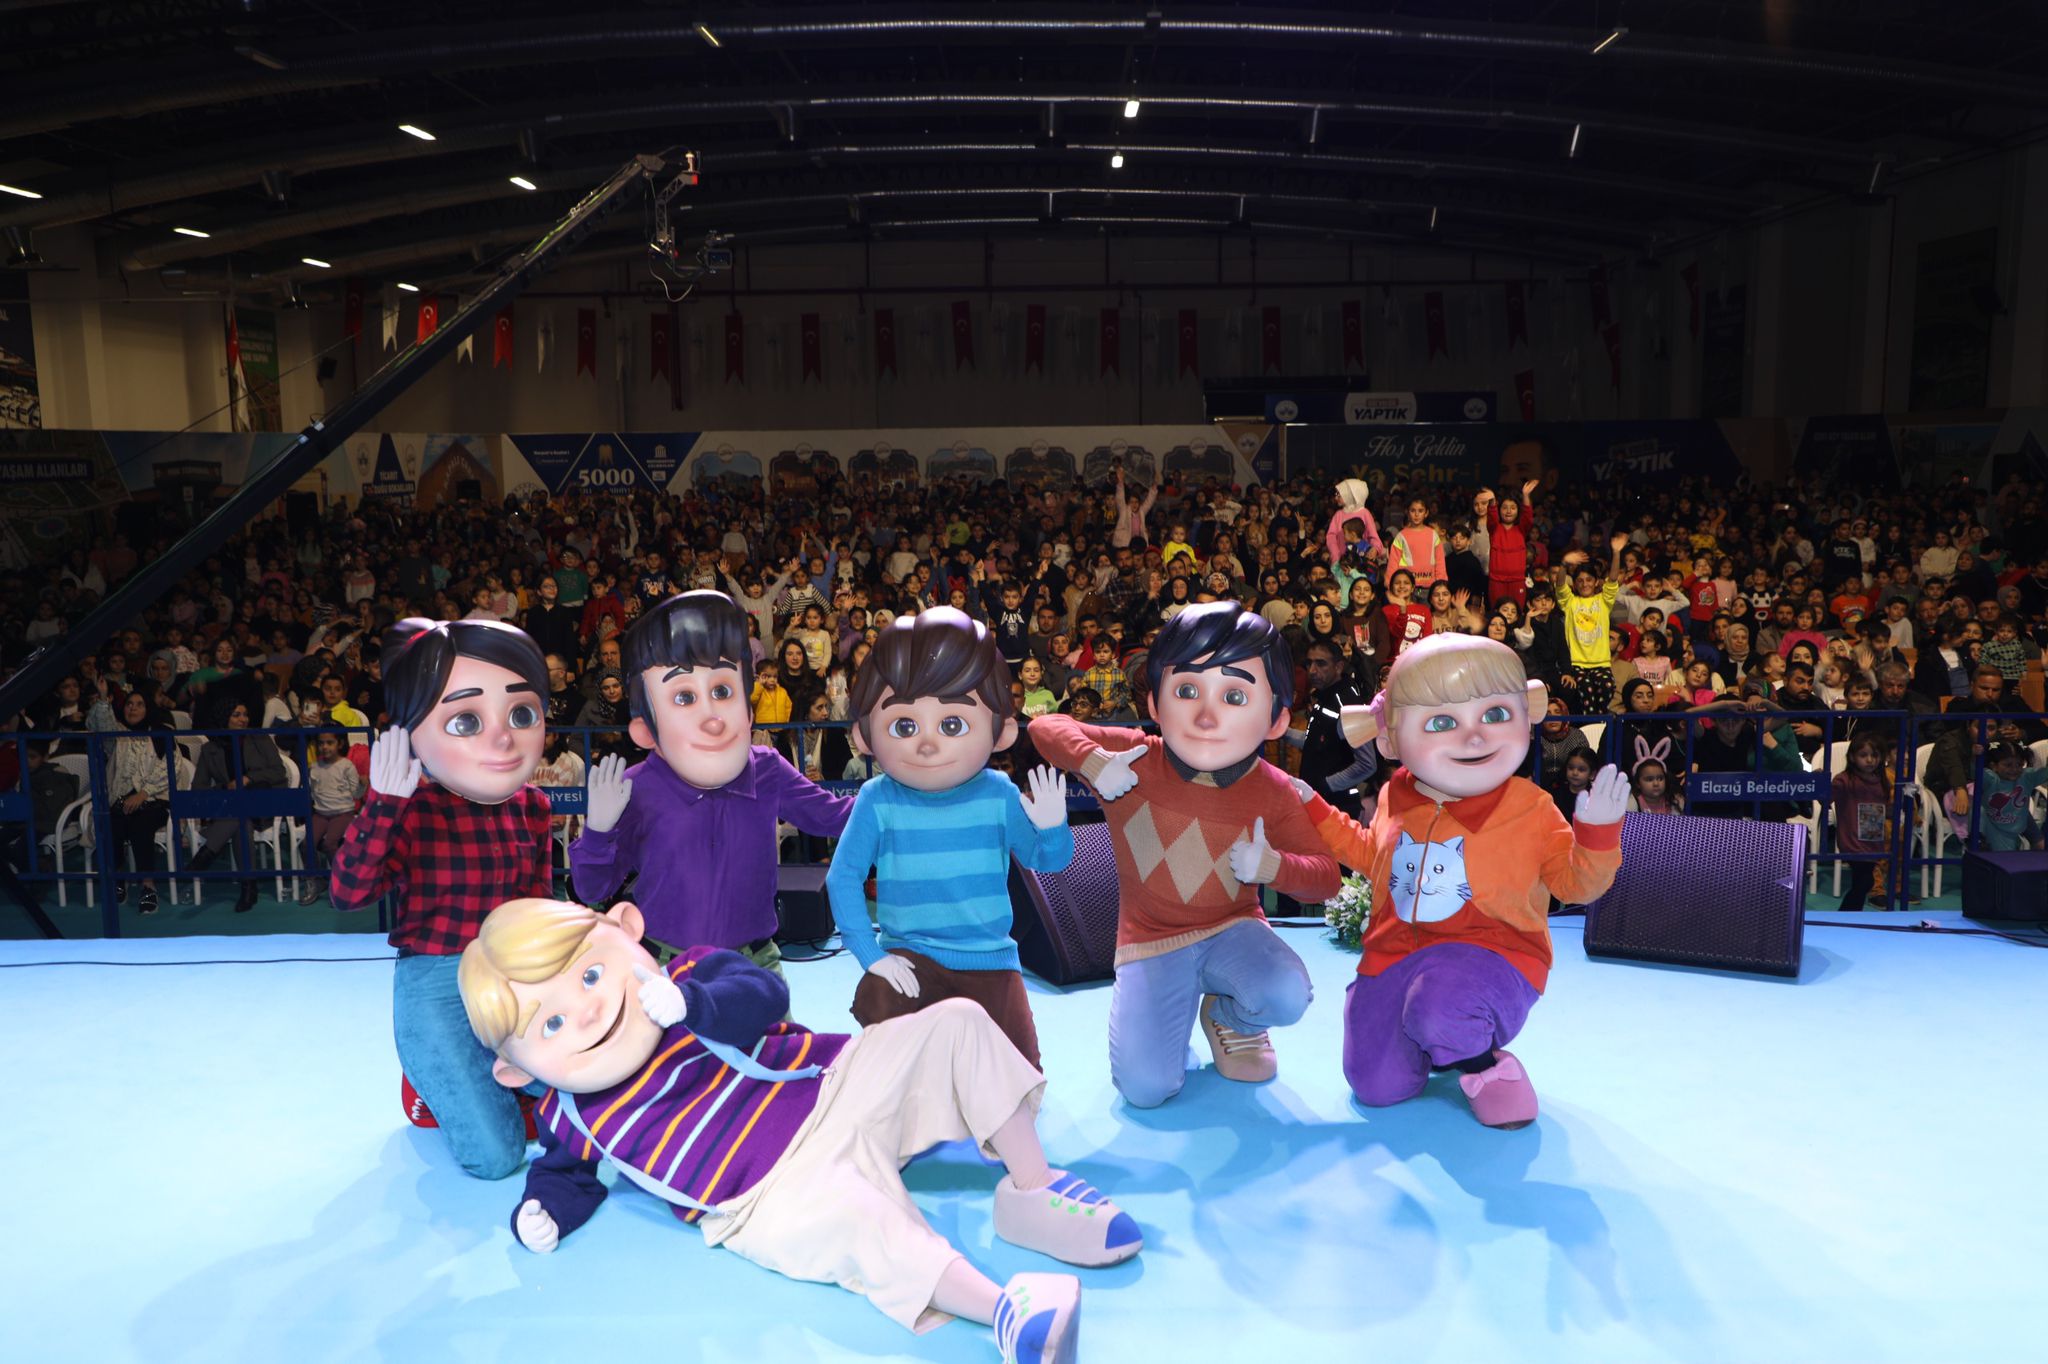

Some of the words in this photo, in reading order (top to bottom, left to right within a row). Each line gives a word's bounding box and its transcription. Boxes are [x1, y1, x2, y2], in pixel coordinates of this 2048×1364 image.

[1354, 407, 1408, 421] YAPTIK
[1364, 434, 1406, 459] Hoş
[1410, 434, 1466, 464] Geldin
[36, 463, 88, 479] ALANLARI
[578, 468, 635, 488] 5000
[1701, 781, 1742, 796] Elazığ
[1746, 780, 1816, 796] Belediyesi
